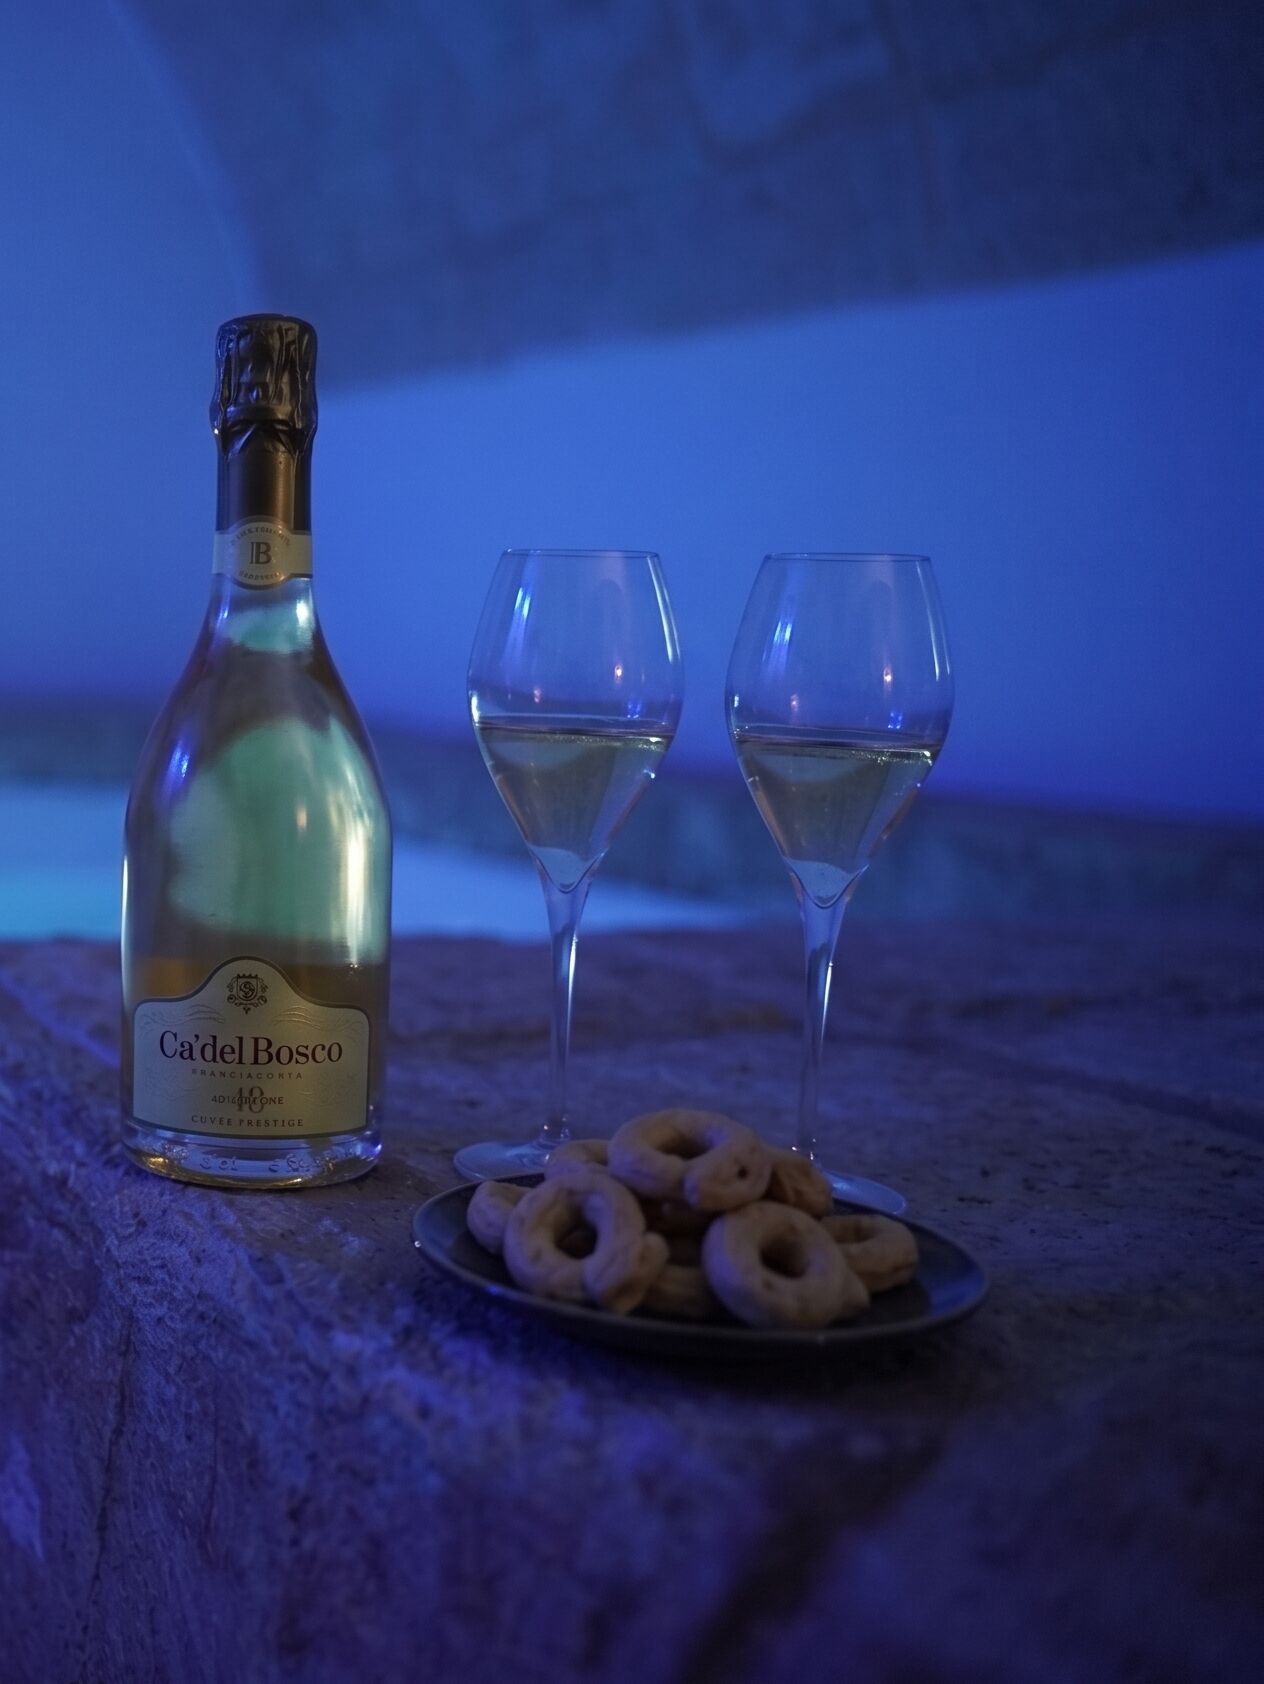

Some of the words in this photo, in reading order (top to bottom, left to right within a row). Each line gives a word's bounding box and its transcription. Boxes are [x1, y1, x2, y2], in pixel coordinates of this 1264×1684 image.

[250, 1037, 343, 1066] Bosco
[191, 1068, 303, 1080] FRANCIACORTA
[238, 1118, 305, 1128] PRESTIGE
